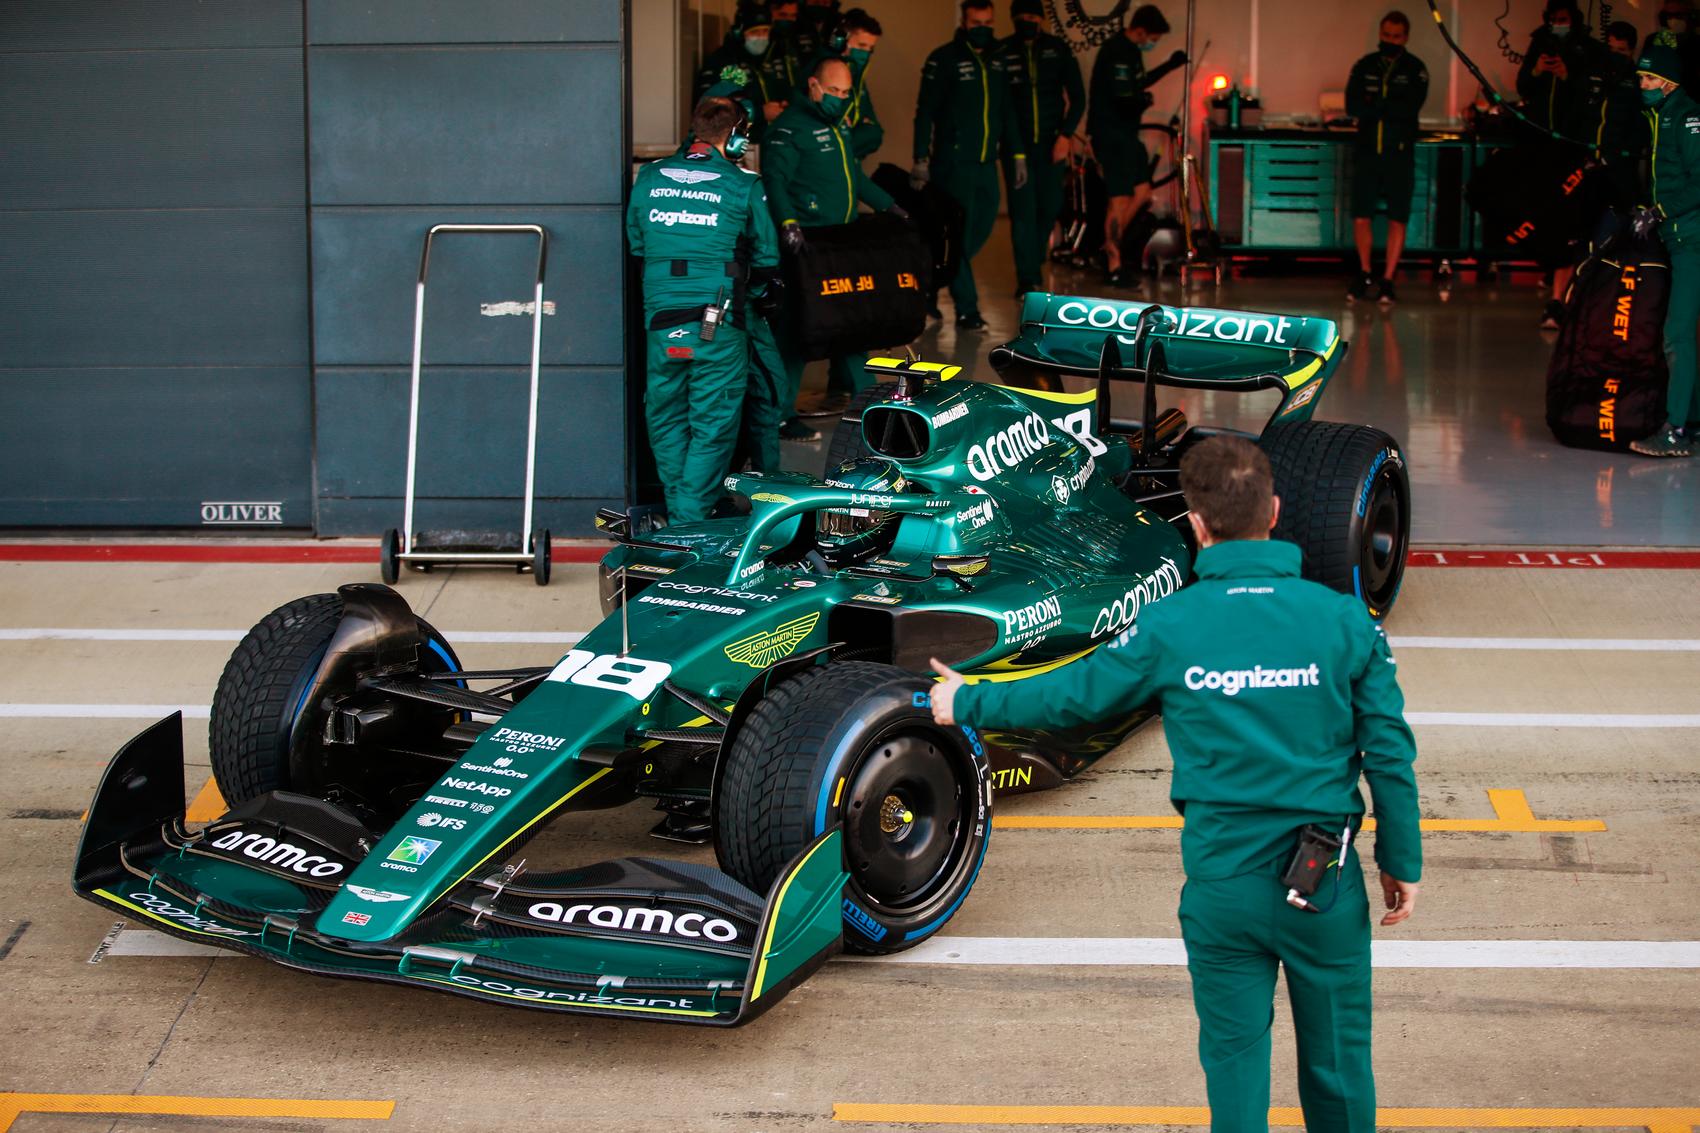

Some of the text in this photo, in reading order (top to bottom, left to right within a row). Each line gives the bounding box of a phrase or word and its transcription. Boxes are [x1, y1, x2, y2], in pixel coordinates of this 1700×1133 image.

[649, 188, 721, 203] ASTON MARTIN
[649, 208, 719, 226] Cognizant
[820, 275, 874, 296] RF WET
[1613, 265, 1636, 341] LF WET
[1599, 398, 1616, 442] WET
[967, 411, 1049, 481] aramco
[201, 505, 282, 521] OLIVER
[956, 501, 982, 523] Sentinel
[972, 516, 987, 528] One
[741, 560, 764, 578] aramco
[658, 582, 778, 603] cognizant
[1091, 557, 1183, 639] cognizant
[638, 595, 746, 616] BOMBARDIER
[1003, 595, 1062, 635] PERONI
[751, 629, 794, 653] ASTON MARTIN
[1004, 618, 1062, 645] NASTRO AZZURRO
[544, 649, 672, 700] 18
[1184, 663, 1319, 696] Cognizant
[493, 728, 566, 748] PERONI
[460, 762, 528, 779] SentinelOne
[441, 777, 512, 798] NetApp
[438, 817, 467, 831] IFS
[211, 831, 344, 877] aramco
[380, 860, 418, 874] aramco
[528, 902, 738, 941] aramco
[452, 975, 694, 1009] cognizant
